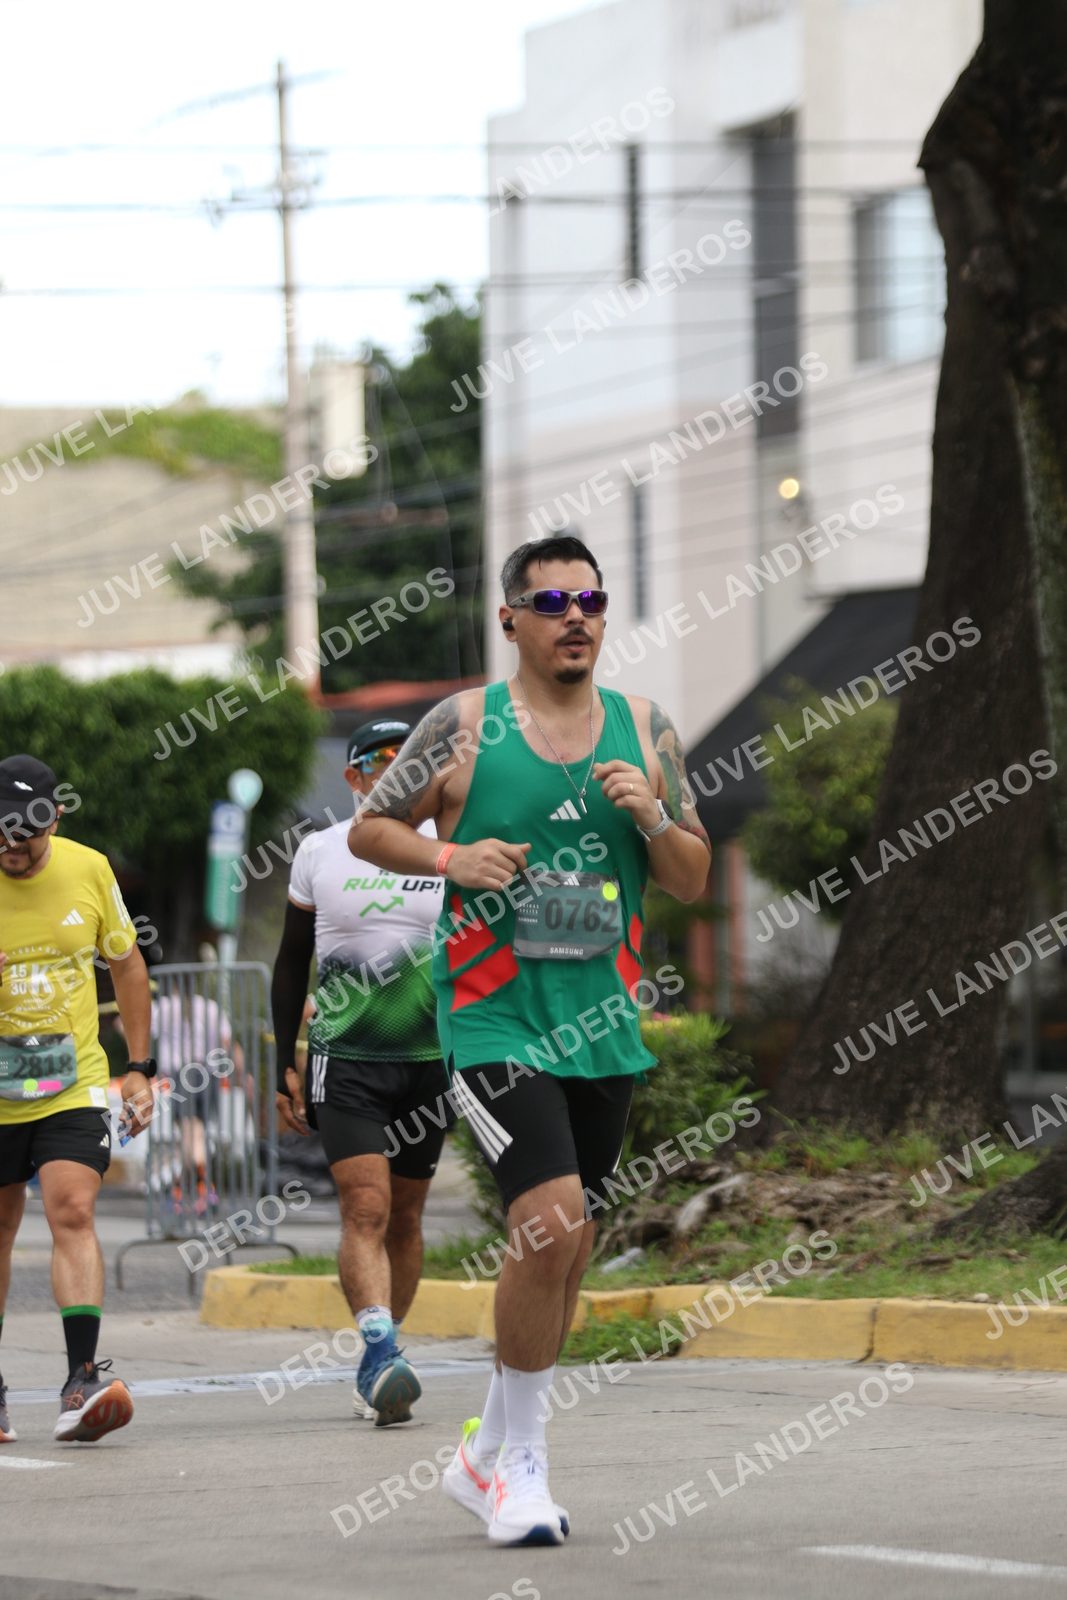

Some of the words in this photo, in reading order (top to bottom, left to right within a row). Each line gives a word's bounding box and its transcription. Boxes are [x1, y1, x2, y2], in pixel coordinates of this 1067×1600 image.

[342, 878, 397, 891] RUN
[402, 879, 441, 894] UP!
[544, 897, 619, 932] 0762
[549, 947, 584, 956] SAMSUNG
[10, 964, 27, 977] 15
[31, 963, 52, 994] K
[10, 982, 27, 995] 30
[12, 1052, 74, 1078] 2818
